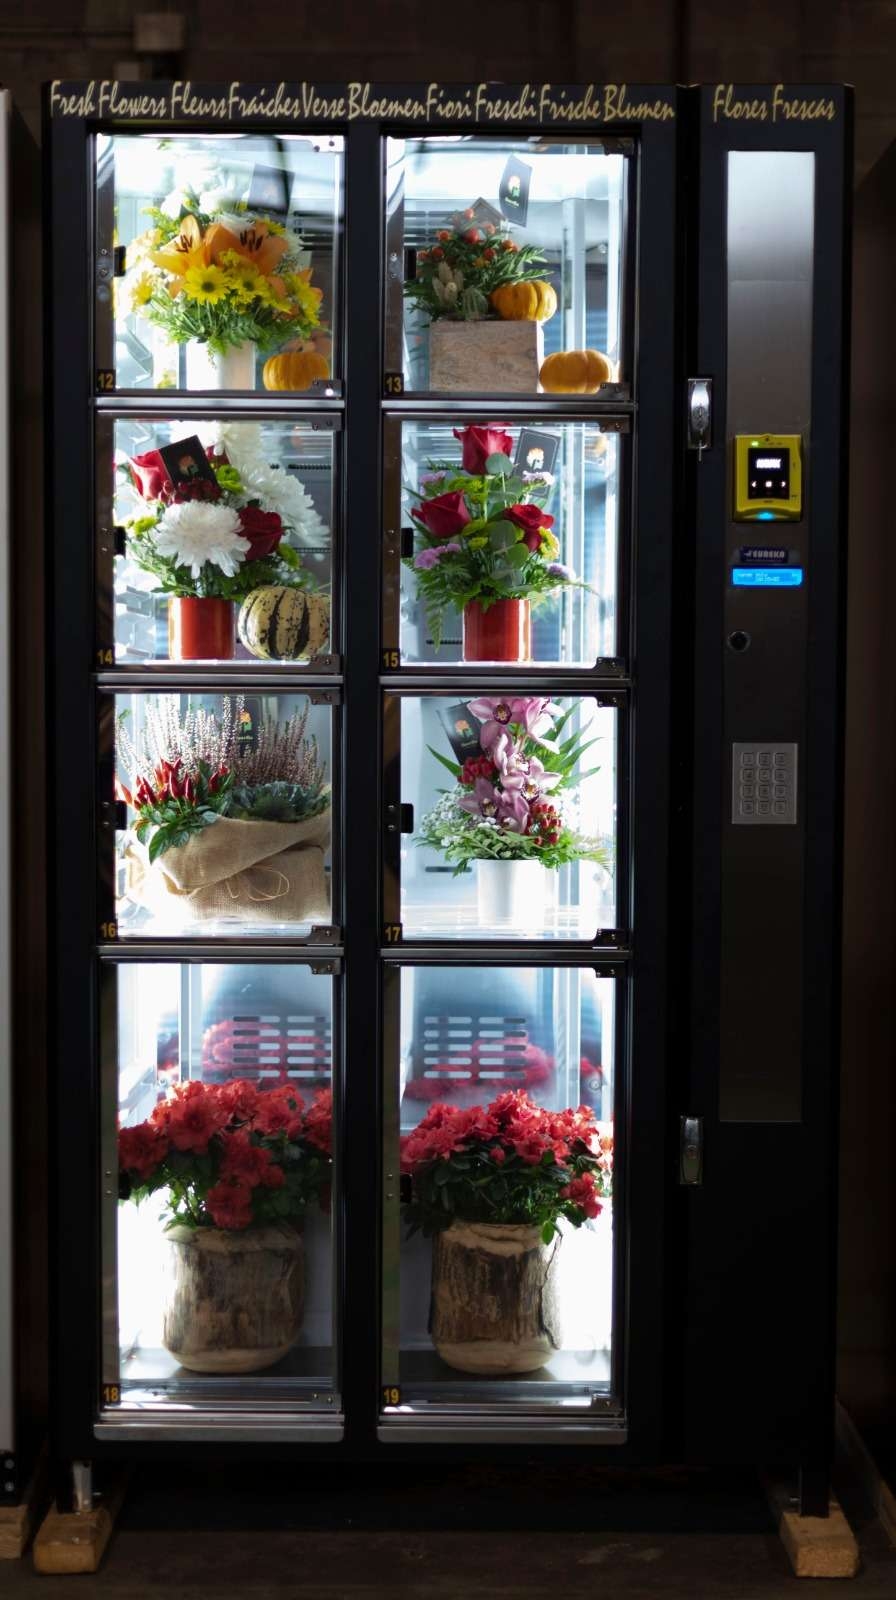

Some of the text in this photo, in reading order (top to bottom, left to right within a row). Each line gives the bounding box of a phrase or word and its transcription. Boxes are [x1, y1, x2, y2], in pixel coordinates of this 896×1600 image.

[50, 80, 96, 117] Fresh
[99, 81, 167, 118] Flowers
[171, 82, 226, 119] Fleurs
[301, 82, 346, 119] Verse
[347, 82, 425, 120] Bloemen
[426, 83, 472, 121] Fiori
[475, 83, 537, 121] Freschi
[538, 83, 601, 122] Frische
[603, 84, 675, 121] Blumen
[713, 83, 835, 123] Flores Frescas
[97, 373, 113, 389] 12
[386, 376, 402, 392] 13
[98, 649, 113, 665] 14
[384, 651, 399, 668] 15
[101, 922, 116, 938] 16
[385, 926, 401, 942] 17
[103, 1387, 119, 1402] 18
[383, 1388, 399, 1404] 19
